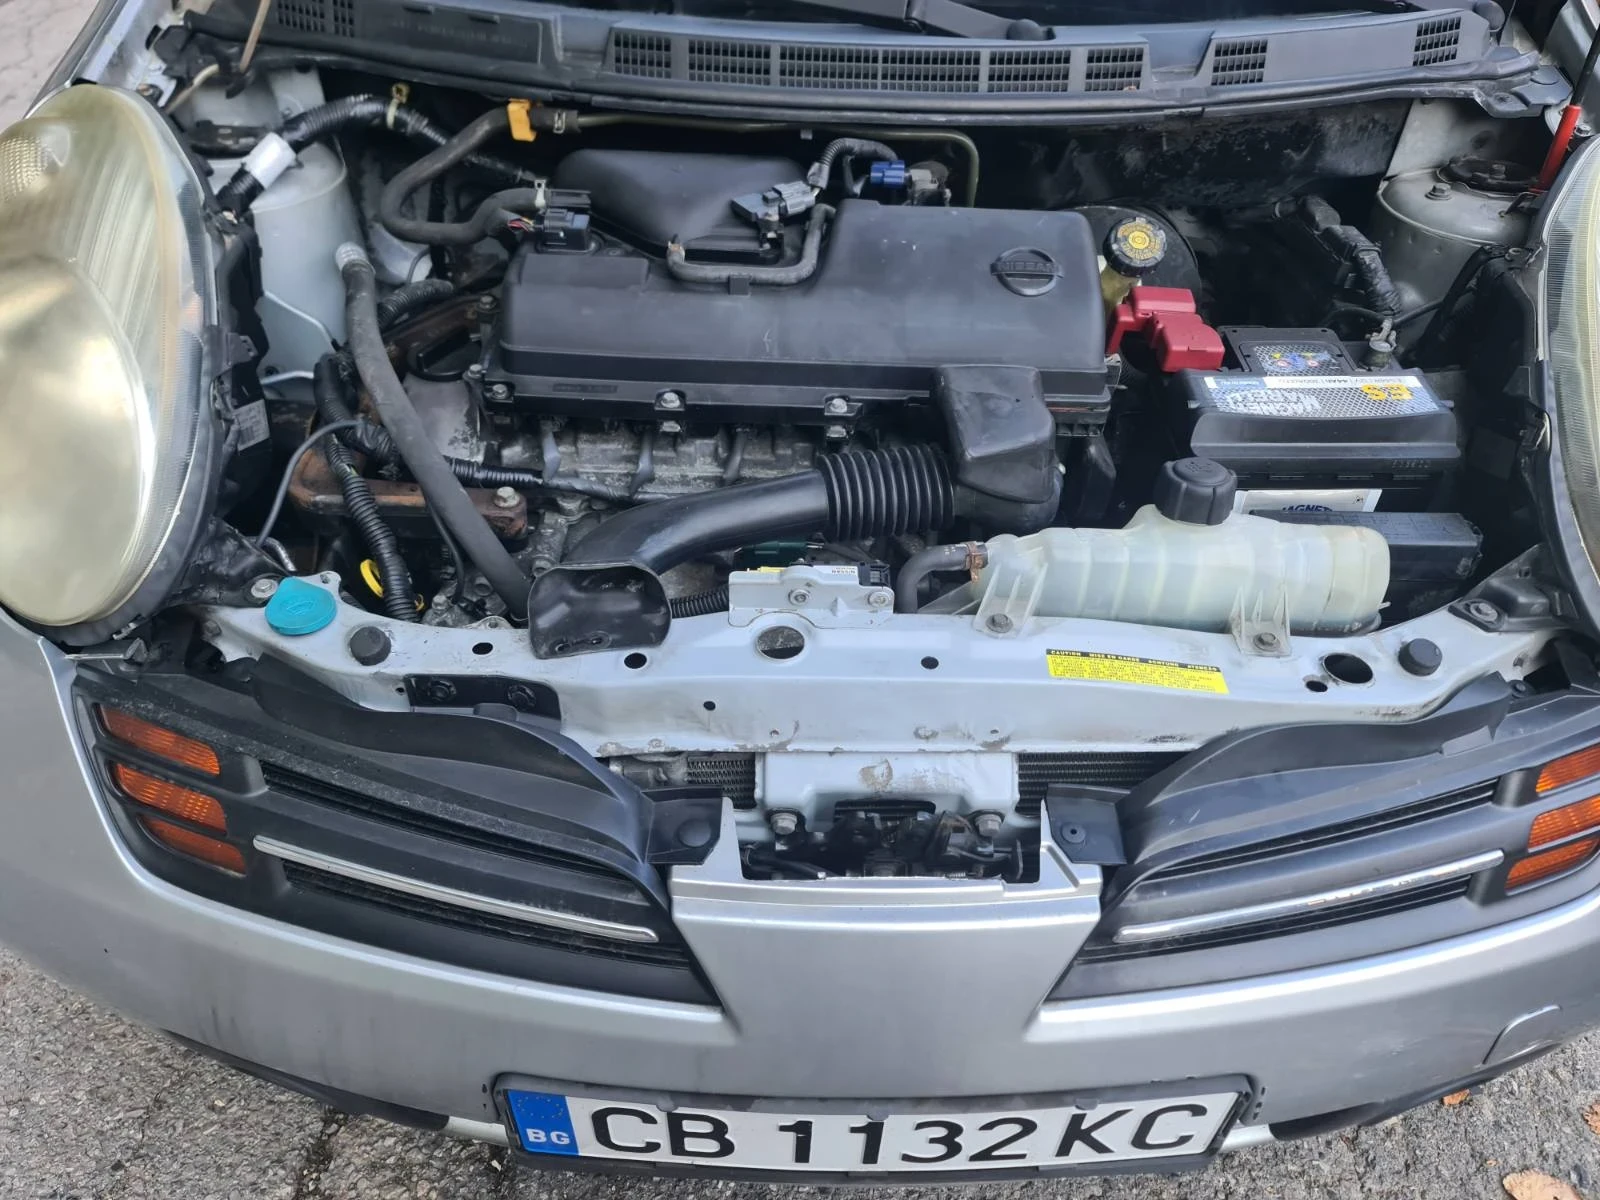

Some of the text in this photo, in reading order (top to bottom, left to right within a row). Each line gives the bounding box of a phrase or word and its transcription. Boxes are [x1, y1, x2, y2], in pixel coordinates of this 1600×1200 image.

[1002, 261, 1056, 272] NISSAN
[526, 1128, 570, 1145] BG
[591, 1103, 1208, 1164] CB 1132 KC
